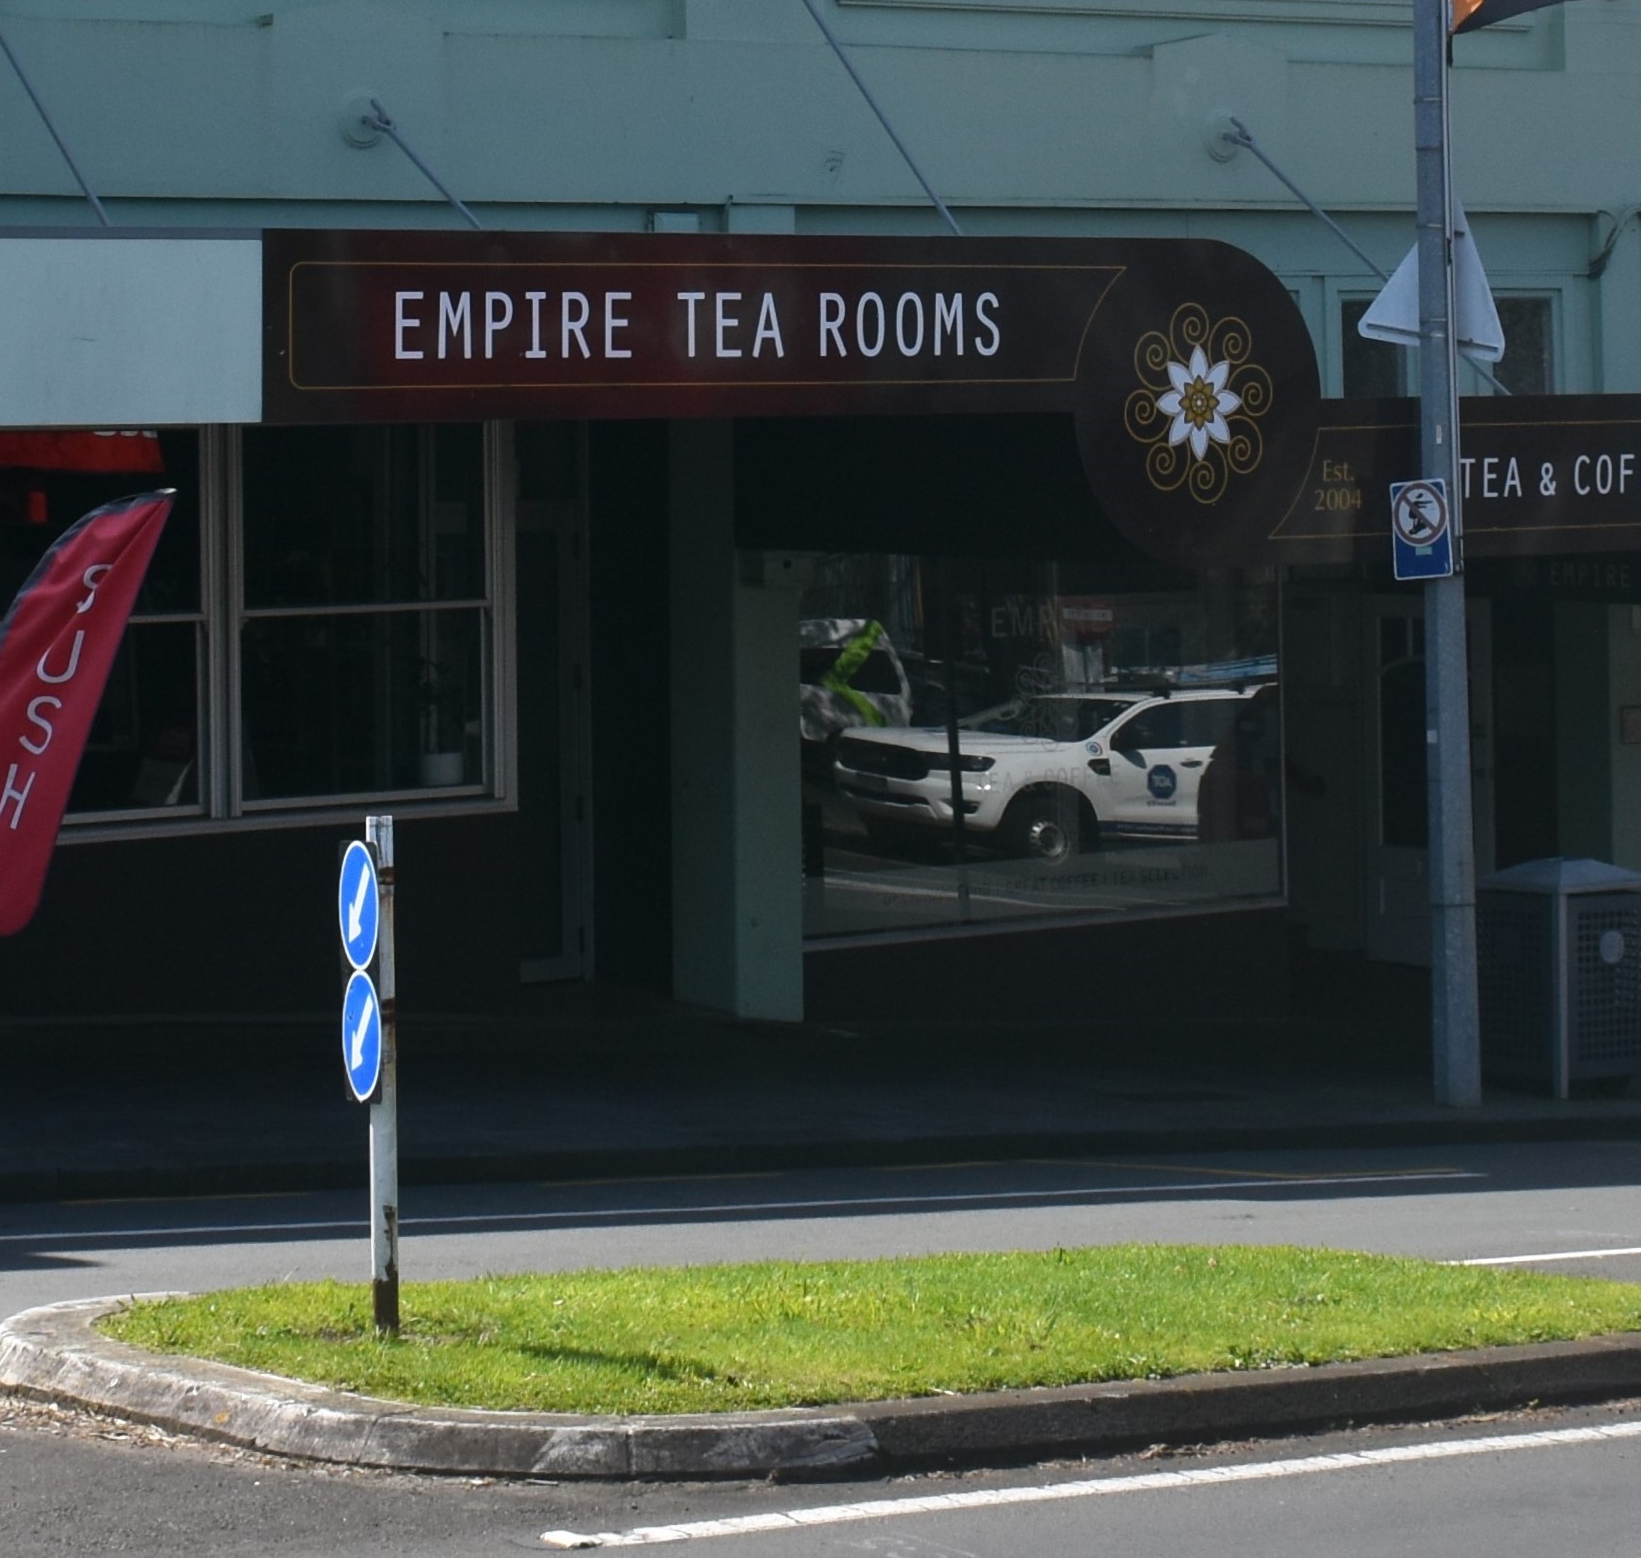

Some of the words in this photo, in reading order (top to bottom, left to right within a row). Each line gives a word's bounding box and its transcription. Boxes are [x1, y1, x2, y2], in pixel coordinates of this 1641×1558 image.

[395, 291, 633, 359] EMPIRE
[677, 292, 785, 358] TEA
[819, 291, 1001, 358] ROOMS
[1323, 459, 1355, 482] Est.
[1459, 458, 1522, 499] TEA
[1539, 462, 1557, 497] &
[1314, 488, 1362, 511] 2004
[1550, 562, 1631, 587] EMPIRE
